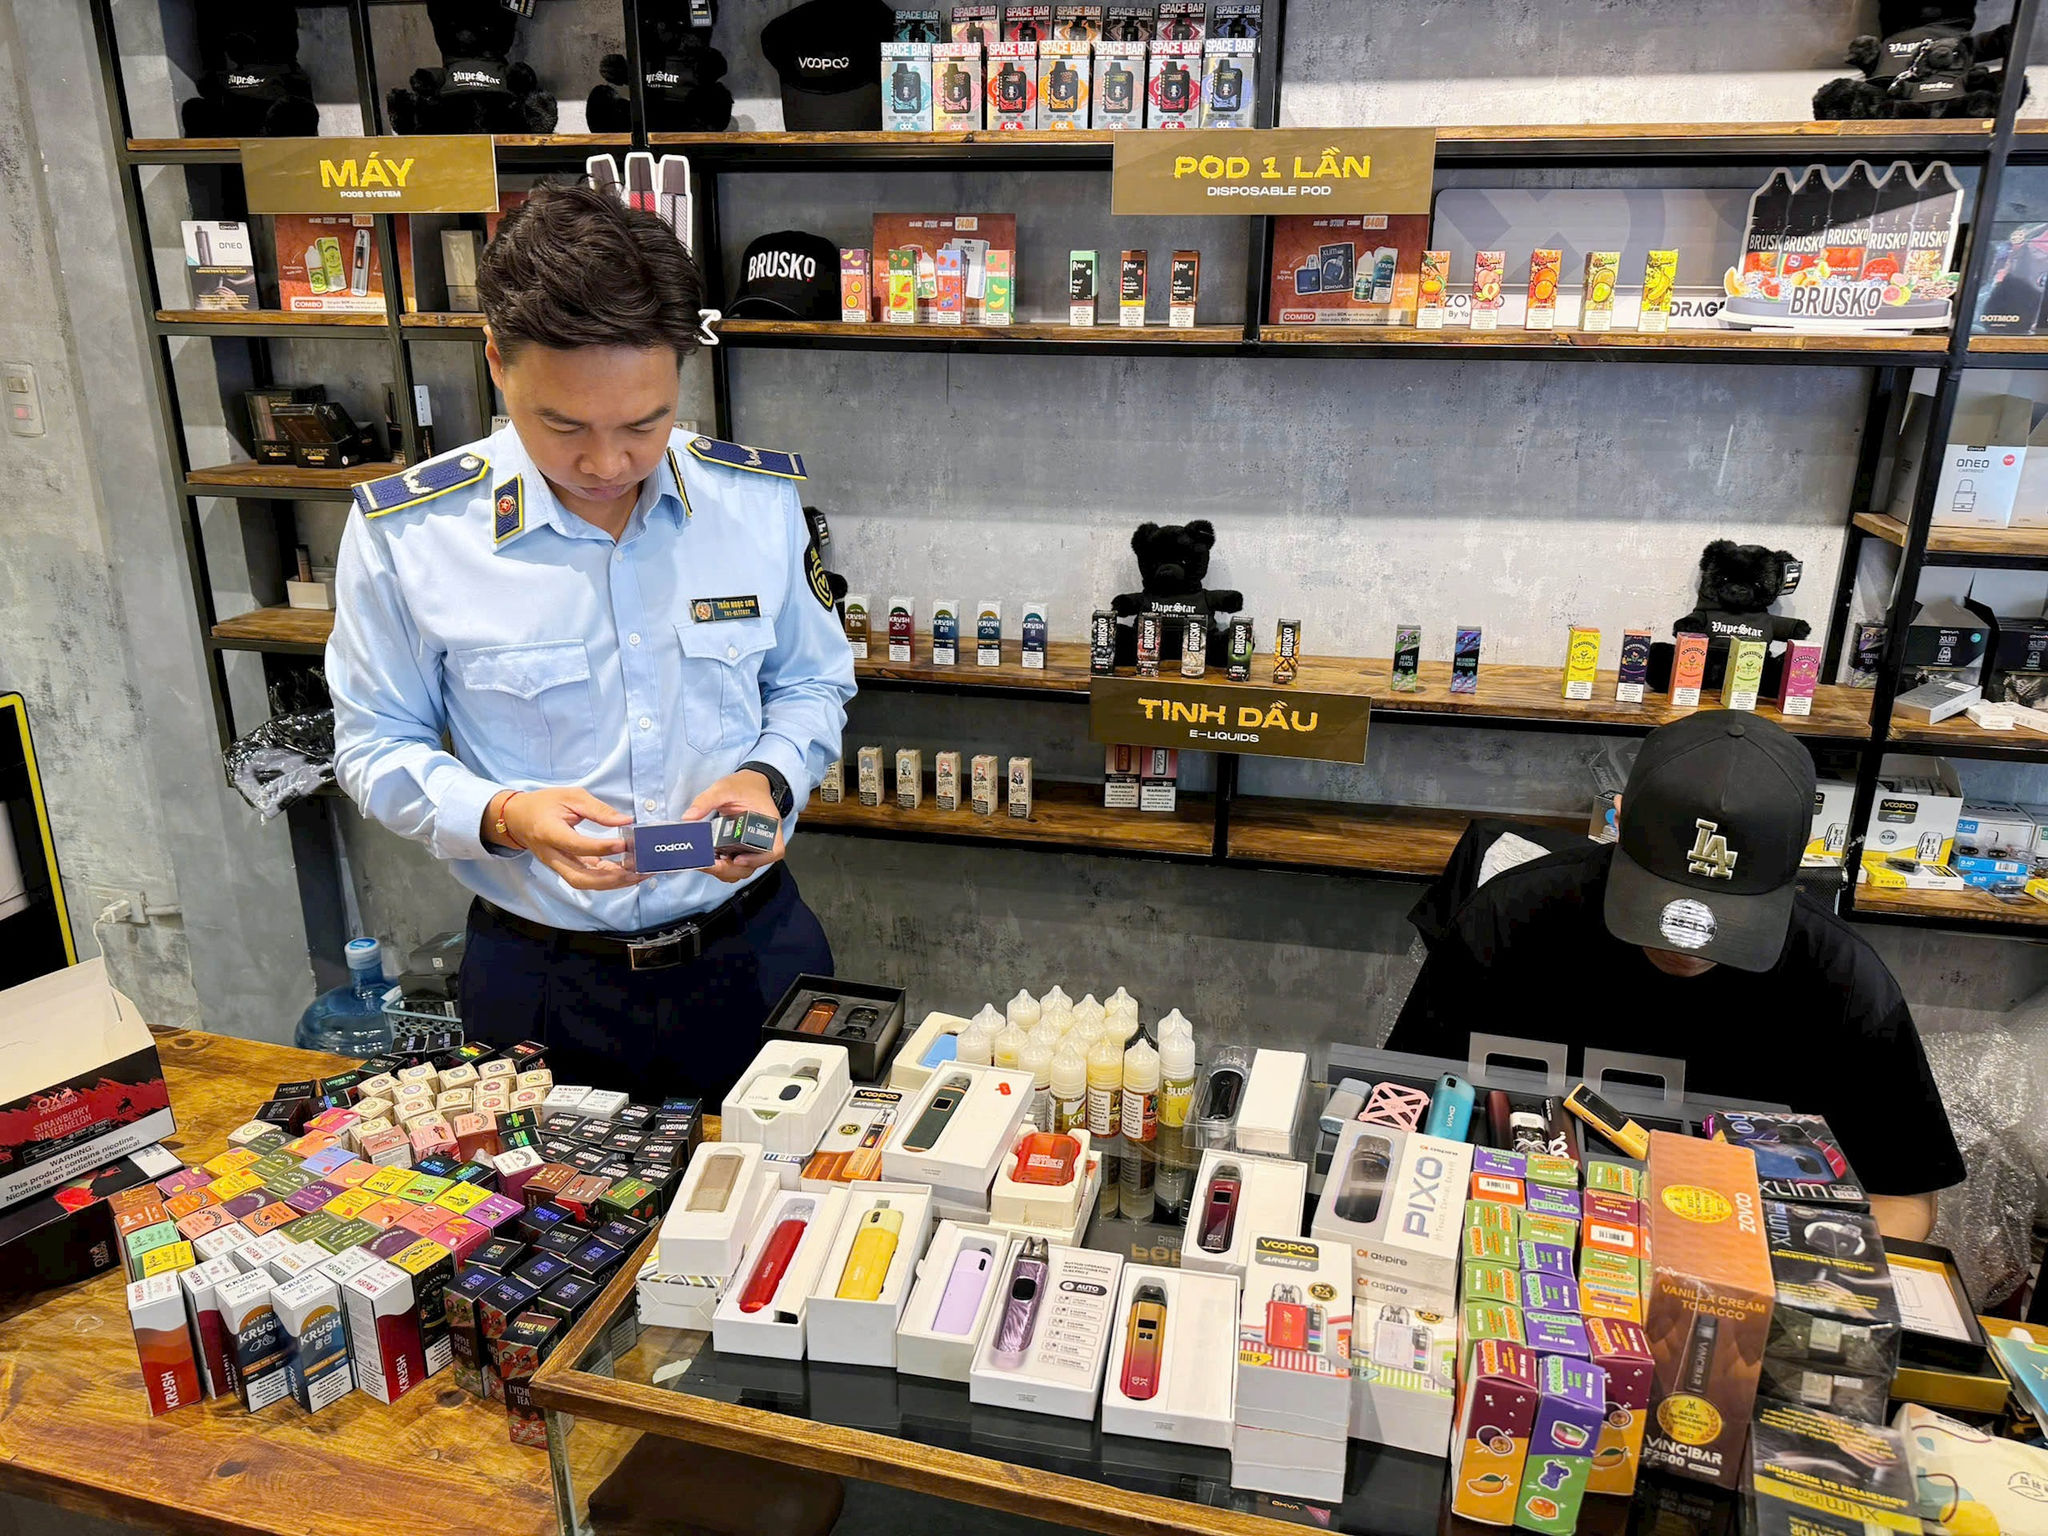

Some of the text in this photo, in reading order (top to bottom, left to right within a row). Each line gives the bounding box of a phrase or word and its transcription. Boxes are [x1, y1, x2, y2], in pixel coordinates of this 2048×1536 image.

[896, 10, 939, 20] SPACE BAR
[954, 5, 997, 17] SPACE BAR
[1007, 6, 1049, 17] SPACE BAR
[1084, 6, 1101, 16] BAR
[1110, 7, 1153, 17] SPACE BAR
[1160, 3, 1204, 13] SPACE BAR
[1216, 5, 1261, 15] SPACE BAR
[881, 43, 929, 57] SPACE BAR
[932, 43, 981, 56] SPACE BAR
[989, 43, 1037, 56] SPACE BAR
[1041, 41, 1089, 55] SPACE BAR
[1095, 42, 1145, 55] SPACE BAR
[1151, 42, 1200, 55] SPACE BAR
[1205, 39, 1254, 52] SPACE BAR
[319, 152, 415, 187] MÁY
[1174, 146, 1372, 179] POD 1 LẦN
[365, 190, 401, 198] SYSTEM
[1207, 185, 1331, 196] DISPOSABLE POD
[1827, 227, 1869, 245] BRUSKO
[747, 251, 816, 283] BRUSKO
[1788, 286, 1883, 317] BRUSKO
[1284, 312, 1315, 321] COMBO
[1151, 602, 1197, 614] VapeStar
[1097, 617, 1107, 646] BRUSKO
[1143, 619, 1154, 649] BRUSKO
[1189, 622, 1200, 651] BRUSKO
[1711, 621, 1763, 638] VapeStar
[1233, 625, 1244, 655] BRUSKO
[1281, 627, 1293, 657] BRUSKO
[1137, 697, 1319, 732] TINH DẦU
[1189, 729, 1260, 744] E-LIQUIDS
[654, 842, 694, 853] VOOPOO
[1687, 818, 1738, 880] LA
[857, 1090, 900, 1100] VOOPOO
[33, 1105, 90, 1132] STRAWBERRY
[35, 1114, 92, 1141] WATERMELON
[50, 1144, 95, 1167] WARNING:
[9, 1135, 137, 1193] This product contains nicotine.
[6, 1183, 43, 1202] Nicotine
[43, 1177, 51, 1187] is
[53, 1173, 64, 1183] an
[66, 1157, 103, 1176] addictive
[1402, 1155, 1444, 1239] PIXO
[1261, 1239, 1316, 1254] VOOPOO
[1263, 1255, 1298, 1267] ARGUS
[1370, 1251, 1408, 1267] aspire
[225, 1272, 259, 1288] KRUSH
[281, 1273, 313, 1291] KRUSH
[1076, 1283, 1100, 1292] AUTO
[1370, 1280, 1408, 1295] aspire
[1661, 1283, 1767, 1313] VANILLA CREAM
[1681, 1299, 1746, 1321] TOBACCO
[300, 1315, 342, 1346] KRUSH
[536, 1323, 549, 1333] TEA
[395, 1354, 411, 1393] KRUSH
[161, 1370, 180, 1409] KRUSH
[516, 1395, 530, 1406] TEA
[1643, 1446, 1685, 1467] F2500
[1645, 1433, 1723, 1466] VINCIBAR
